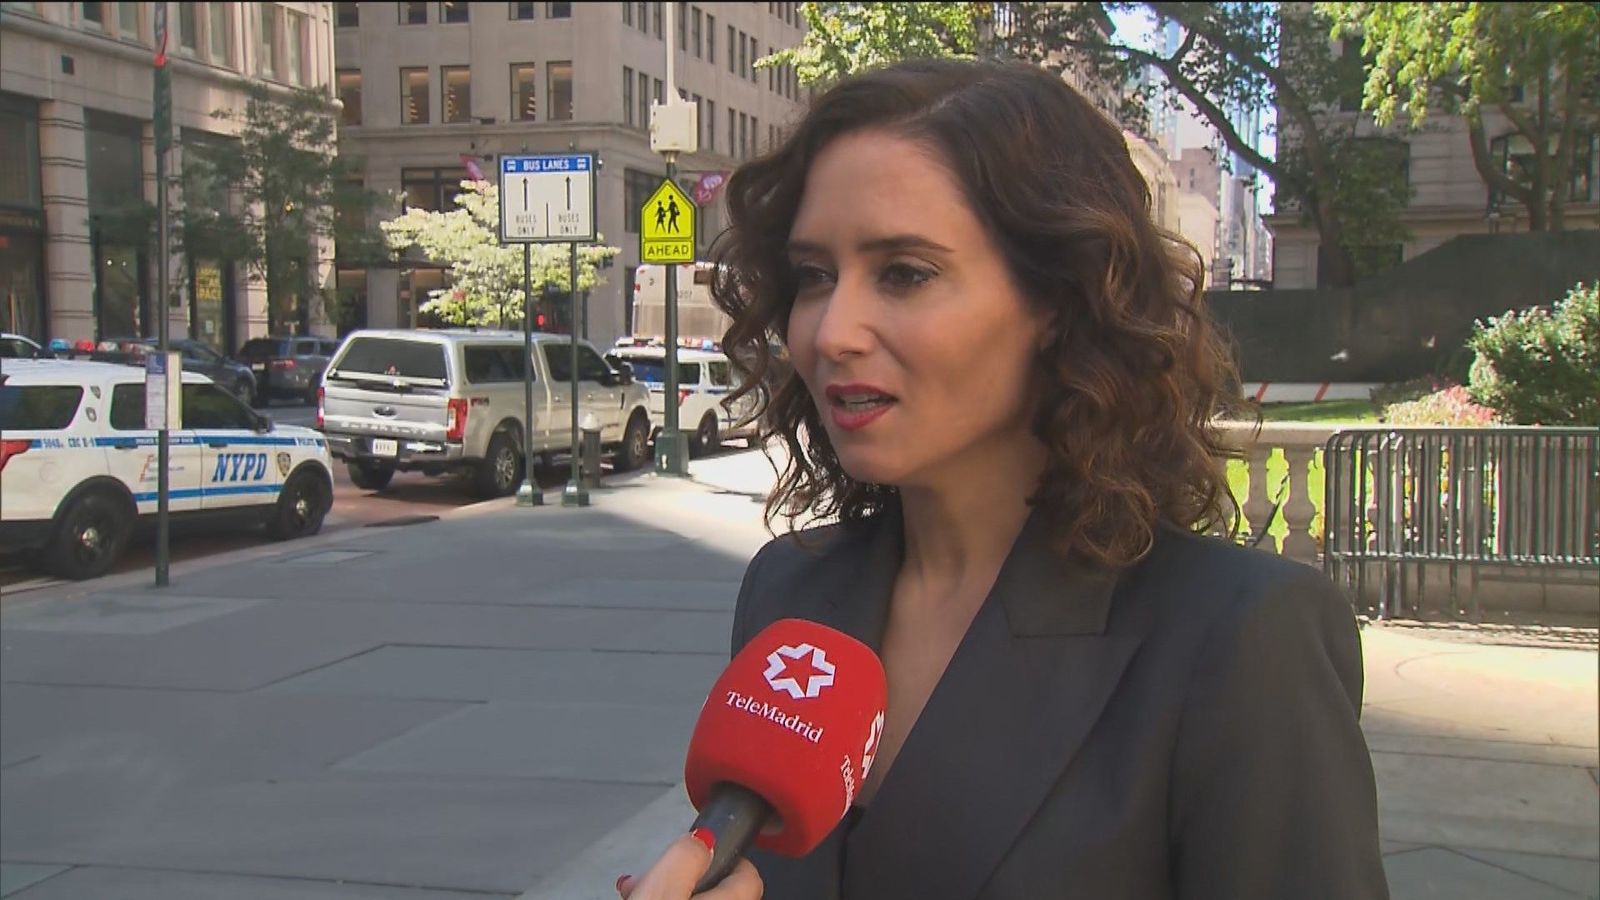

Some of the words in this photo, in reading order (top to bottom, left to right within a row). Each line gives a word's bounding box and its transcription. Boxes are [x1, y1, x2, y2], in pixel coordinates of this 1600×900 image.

[523, 159, 541, 171] BUS
[542, 158, 570, 170] LANES
[515, 214, 537, 225] BUSES
[558, 212, 580, 223] BUSES
[517, 226, 535, 236] ONLY
[560, 225, 578, 235] ONLY
[647, 244, 689, 256] AHEAD
[211, 453, 268, 482] NYPD
[726, 690, 825, 743] TeleMadrid
